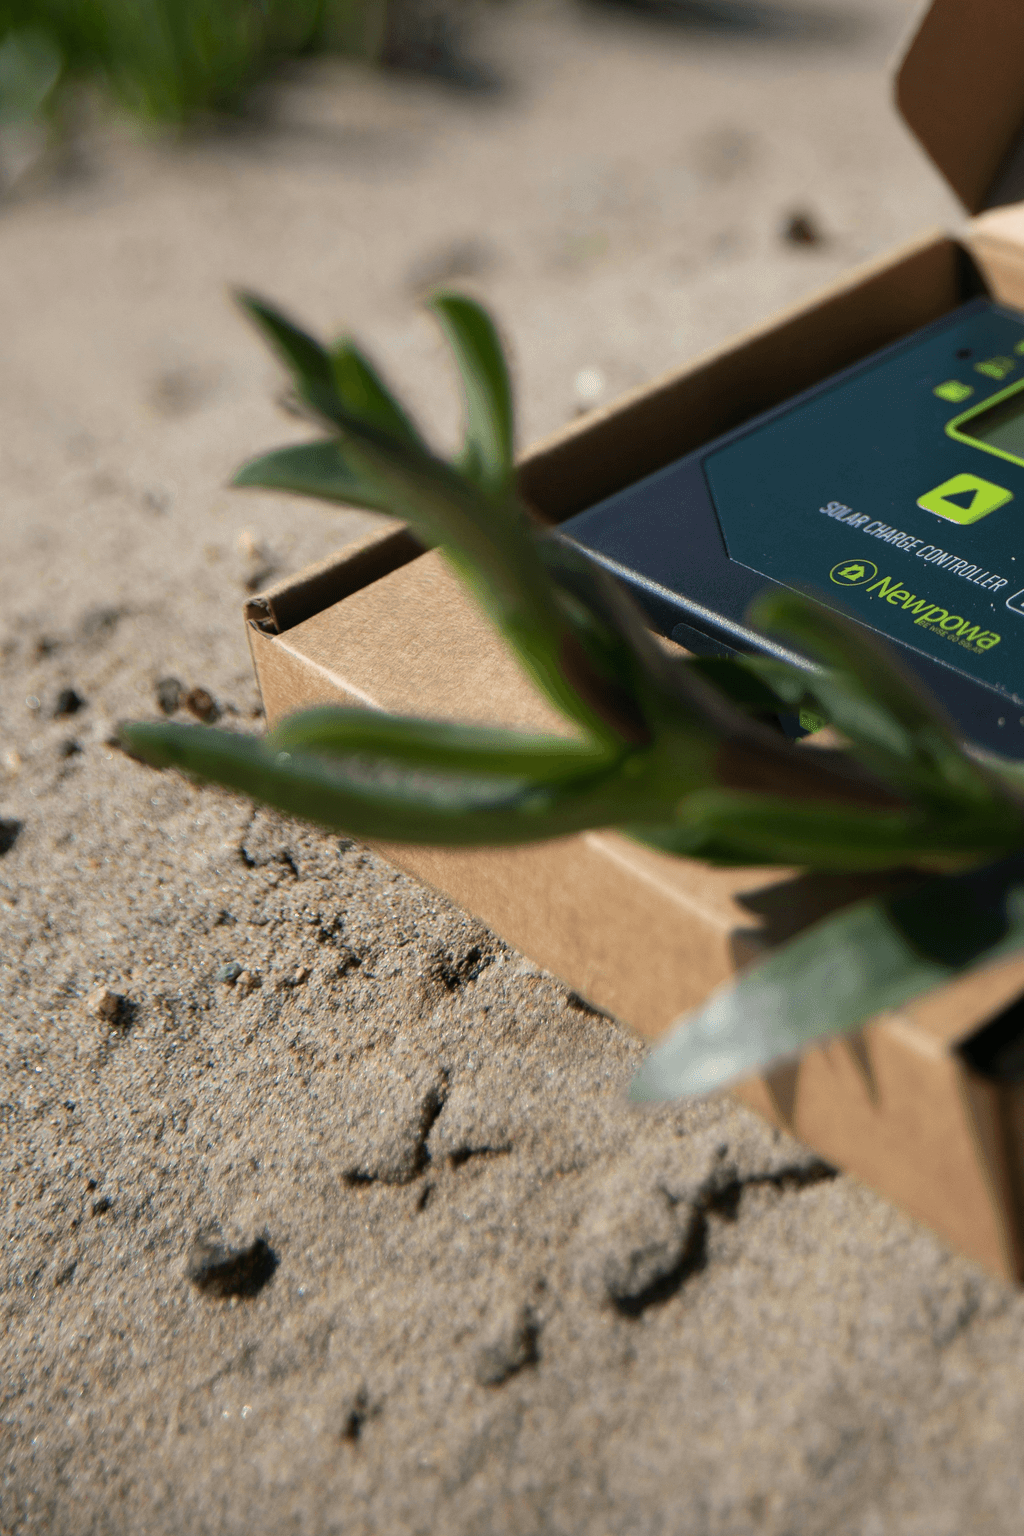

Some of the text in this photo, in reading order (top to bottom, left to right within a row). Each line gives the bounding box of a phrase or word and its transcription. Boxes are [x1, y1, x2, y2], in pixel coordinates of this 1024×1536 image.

[819, 501, 1008, 592] SOLAR CHARGE CONTROLLER
[866, 576, 1001, 650] Newpowa
